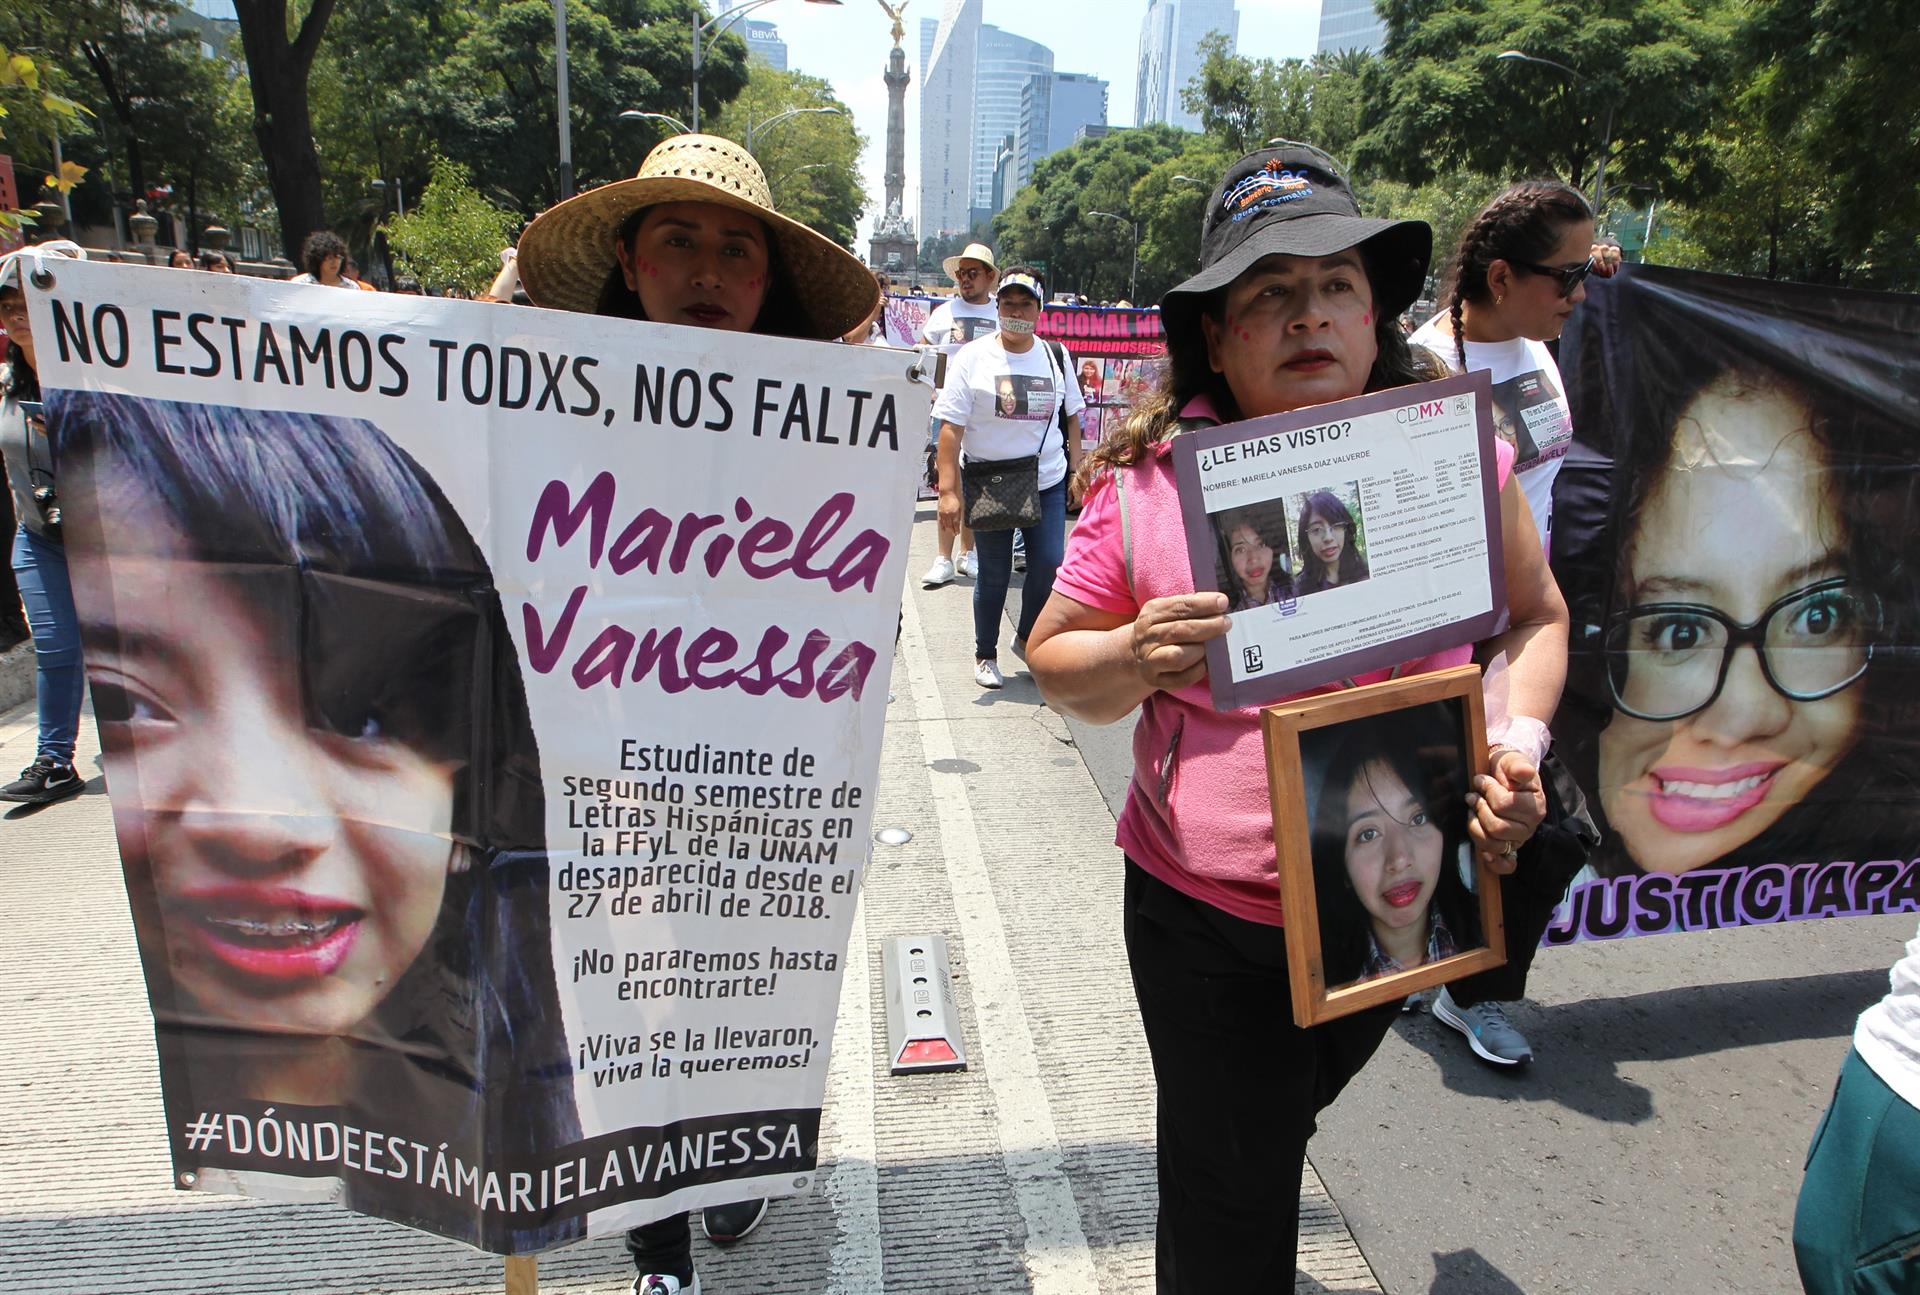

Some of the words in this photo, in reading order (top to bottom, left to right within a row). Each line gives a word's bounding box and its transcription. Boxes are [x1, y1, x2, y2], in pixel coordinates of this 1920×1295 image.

[752, 30, 776, 40] BBVA
[1263, 188, 1313, 206] Termales
[51, 299, 129, 368] NO
[152, 309, 410, 398] ESTAMOS
[429, 340, 617, 428] TODXS,
[634, 364, 734, 431] NOS
[751, 379, 899, 450] FALTA
[1395, 400, 1444, 424] CDMX
[1201, 446, 1236, 471] ¿LE
[1242, 437, 1281, 459] HAS
[1286, 422, 1352, 449] VISTO?
[1203, 478, 1240, 493] NOMBRE:
[1240, 470, 1276, 485] MARIELA
[1277, 462, 1312, 477] VANESSA
[1313, 458, 1331, 468] DIAZ
[1332, 449, 1370, 464] VALVERDE
[1393, 472, 1414, 481] DELGADA
[1380, 510, 1396, 518] COLOR
[1440, 507, 1455, 515] NEGRO
[526, 471, 890, 593] Mariela
[522, 585, 877, 703] Vanessa
[1309, 644, 1326, 653] CENTRO
[1335, 638, 1350, 646] APOYO
[1354, 630, 1377, 641] PERSONAS
[620, 739, 773, 777] Estudiante
[783, 747, 815, 777] de
[563, 776, 684, 803] segundo
[694, 784, 822, 809] semestre
[831, 781, 862, 808] de
[569, 800, 656, 828] Letras
[666, 806, 813, 838] Hispánicas
[822, 817, 853, 839] en
[582, 832, 604, 857] la
[616, 830, 677, 862] FFyL
[688, 835, 718, 857] de
[728, 836, 749, 860] la
[760, 839, 838, 865] UNAM
[559, 860, 736, 895] desaparecida
[746, 865, 822, 892] desde
[831, 870, 854, 894] el
[568, 893, 601, 919] 27
[611, 893, 642, 916] de
[652, 887, 711, 916] abril
[720, 893, 750, 918] de
[760, 893, 830, 919] 2018.
[573, 949, 614, 983] ¡No
[624, 949, 760, 978] pararemos
[769, 946, 837, 971] hasta
[618, 973, 777, 1001] encontrarte!
[579, 1033, 640, 1070] ¡Viva
[649, 1030, 675, 1051] se
[685, 1028, 704, 1052] la
[714, 1026, 819, 1050] llevaron,
[594, 1061, 642, 1088] viva
[652, 1054, 670, 1078] la
[680, 1048, 810, 1079] queremos!
[186, 1107, 801, 1213] #DÓNDEESTÁMARIELAVANESSA
